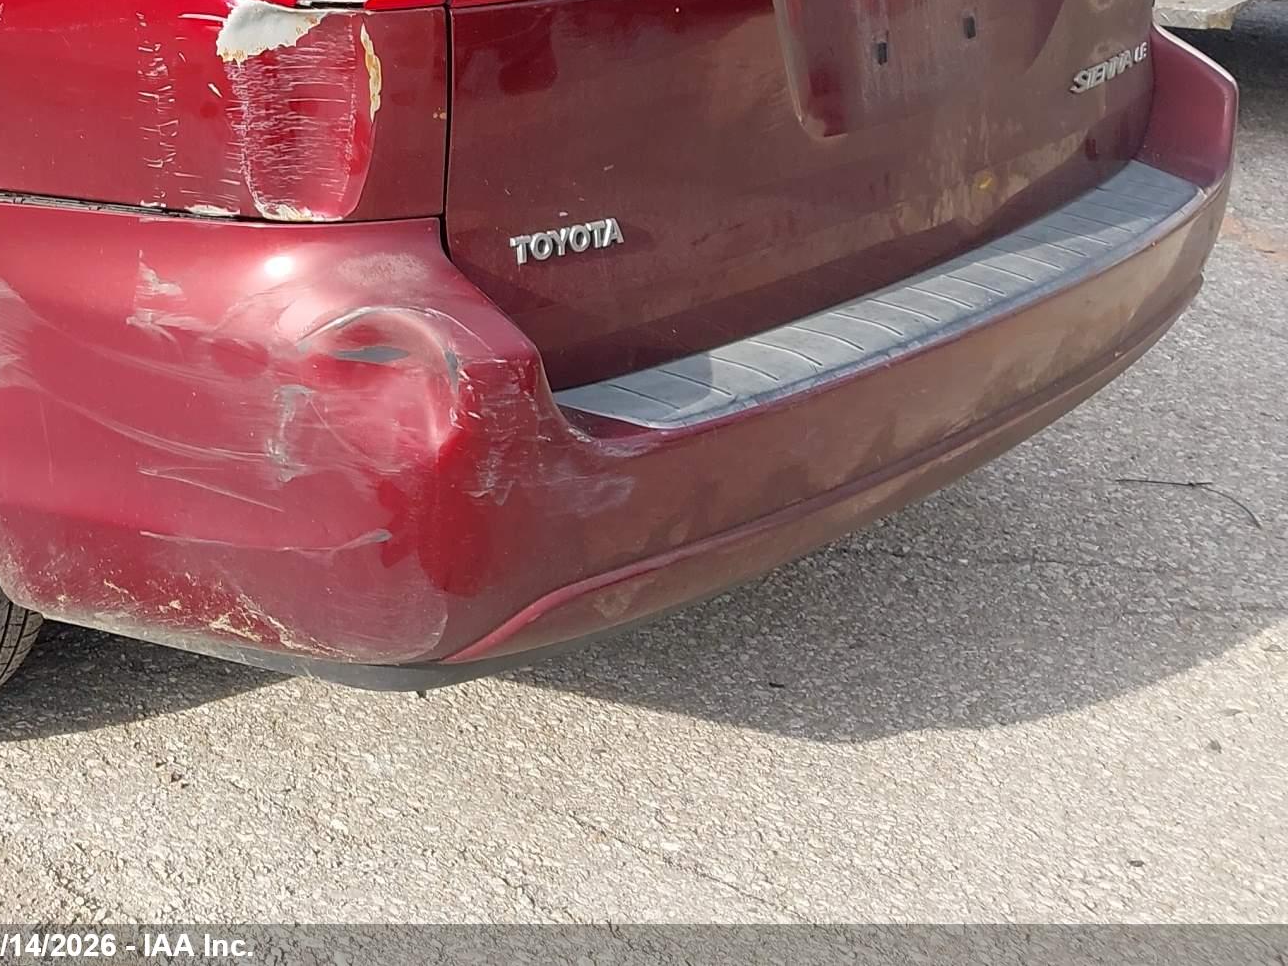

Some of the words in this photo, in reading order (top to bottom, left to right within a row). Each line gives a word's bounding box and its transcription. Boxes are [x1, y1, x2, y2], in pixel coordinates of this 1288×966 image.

[1069, 49, 1132, 93] SIENNA
[1134, 41, 1148, 63] LE
[509, 217, 625, 265] TOYOTA
